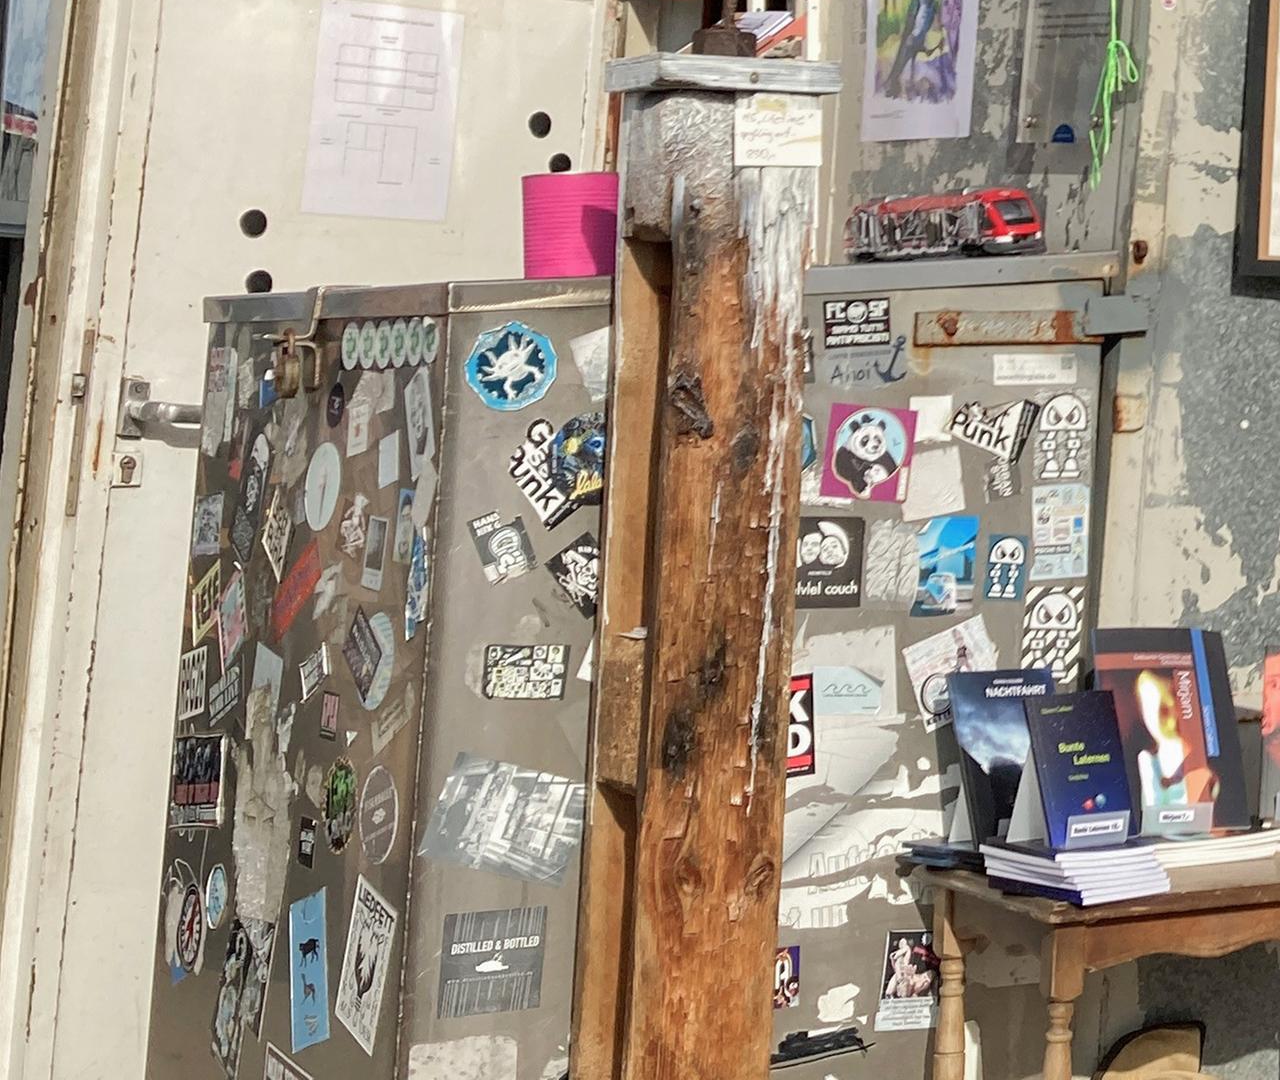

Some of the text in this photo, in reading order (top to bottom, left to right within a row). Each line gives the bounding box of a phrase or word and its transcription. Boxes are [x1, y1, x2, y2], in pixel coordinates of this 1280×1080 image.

[826, 302, 846, 319] FC
[1058, 740, 1085, 754] Bunte
[451, 935, 540, 956] DISTILLED & BOTTLED
